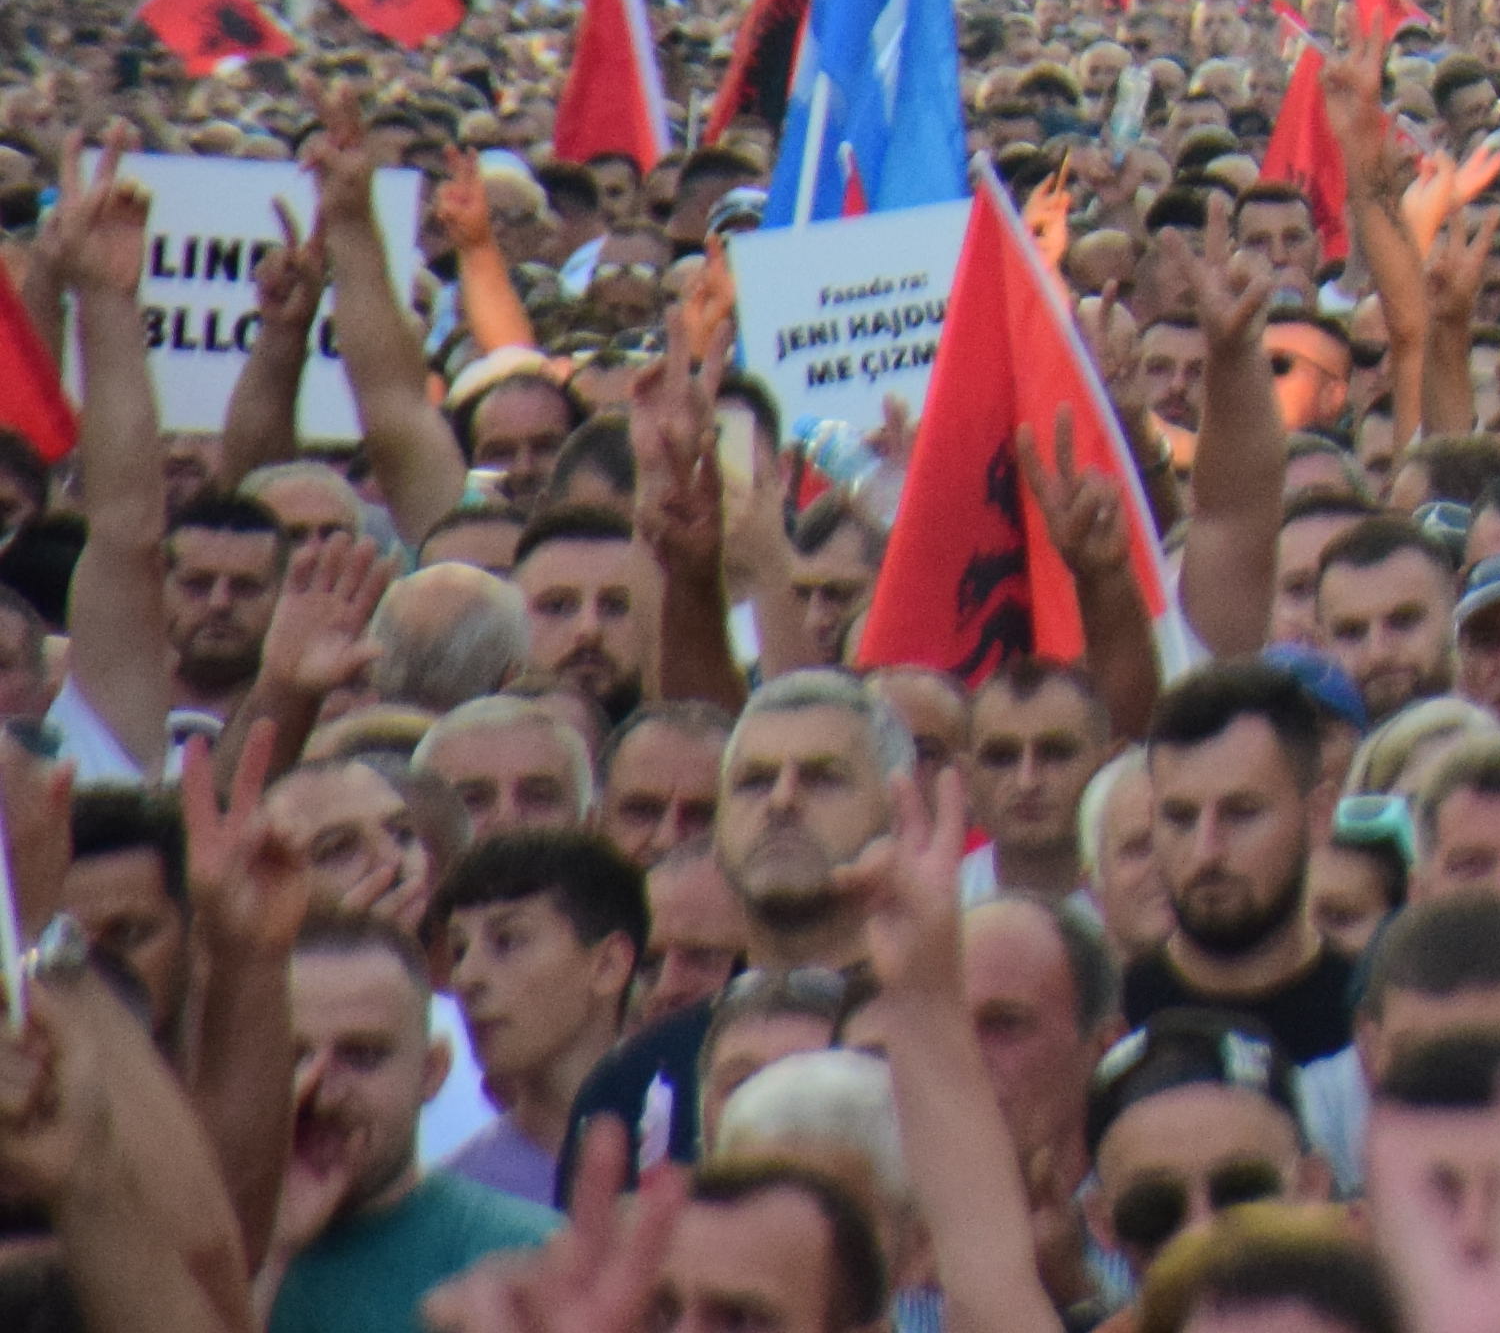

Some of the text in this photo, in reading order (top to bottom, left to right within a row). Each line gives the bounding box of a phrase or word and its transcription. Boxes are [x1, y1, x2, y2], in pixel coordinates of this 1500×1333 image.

[777, 297, 946, 362] JENI HAJDU
[807, 338, 938, 387] ME ÇIZM
